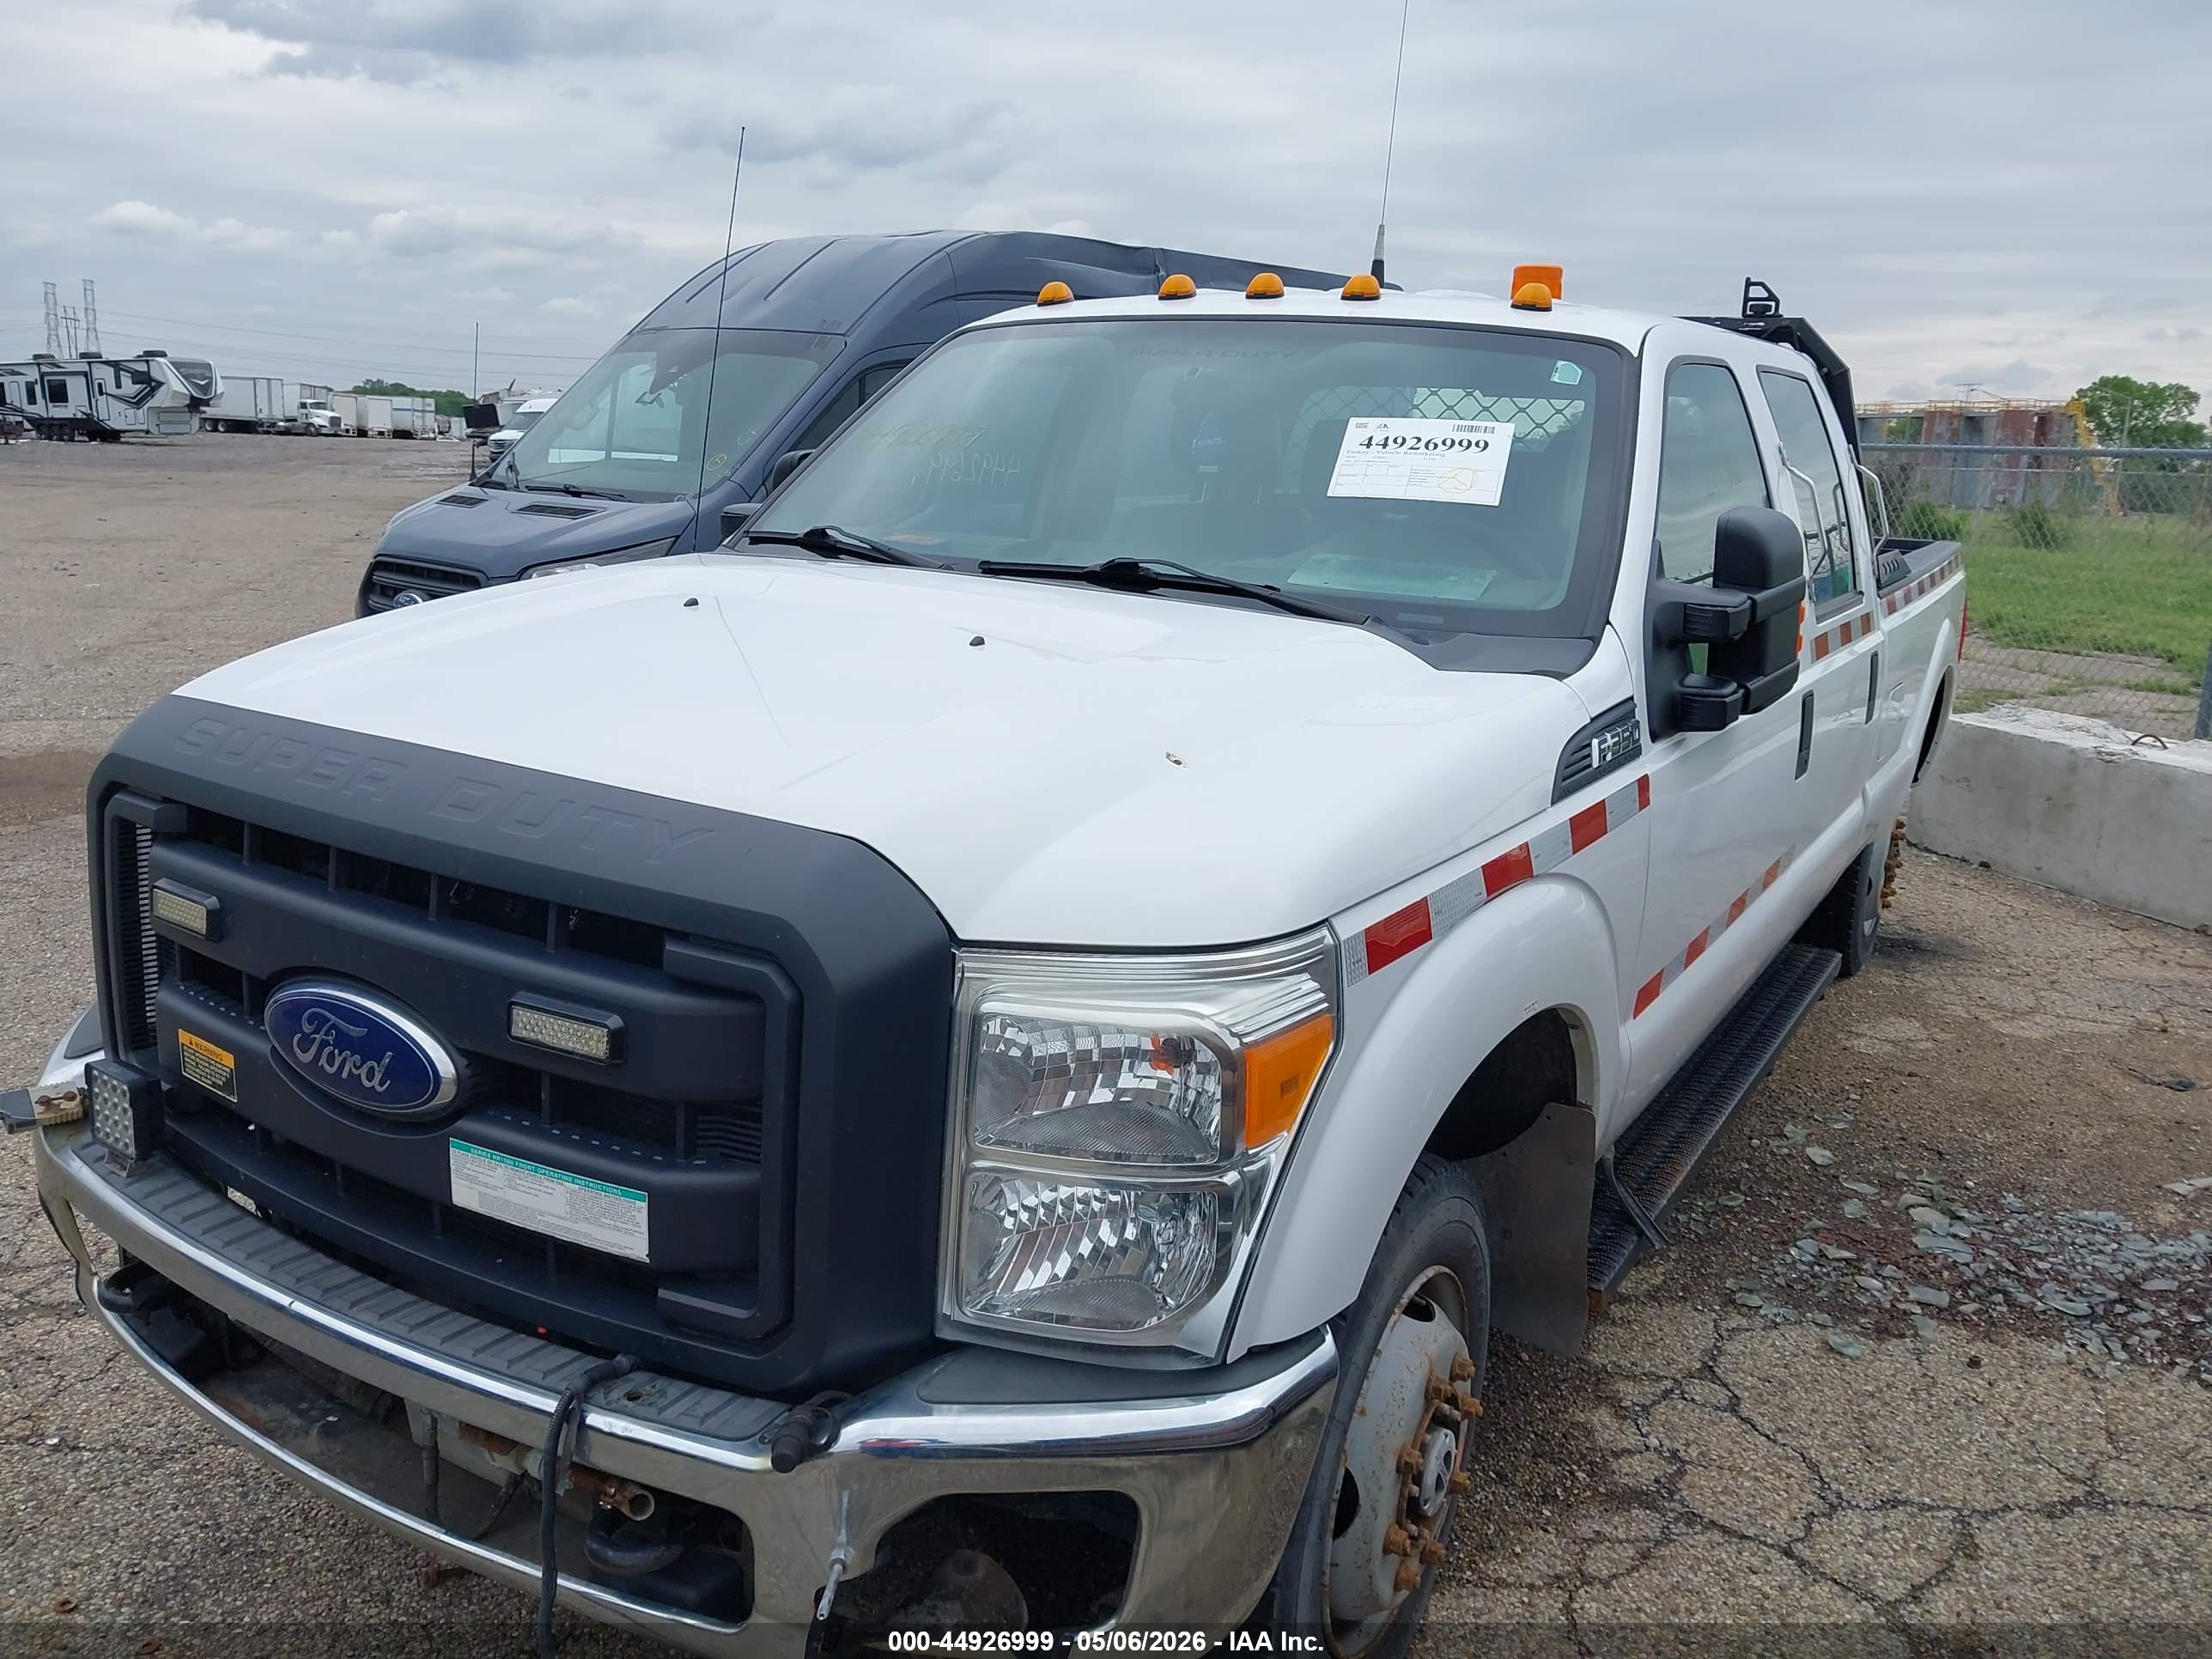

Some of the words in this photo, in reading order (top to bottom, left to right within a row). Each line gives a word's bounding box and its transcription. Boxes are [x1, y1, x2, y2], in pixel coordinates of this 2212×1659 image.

[1358, 434, 1490, 454] 44926999
[1402, 450, 1446, 459] Remarketing
[174, 717, 409, 803] SUPER
[428, 776, 719, 865] DUTY
[195, 1042, 223, 1062] WARNING
[293, 1008, 392, 1092] Ford
[470, 1148, 491, 1158] SERIES
[515, 1159, 535, 1171] FRONT
[537, 1167, 573, 1182] OPERATING
[574, 1177, 622, 1195] INSTRUCTIONS
